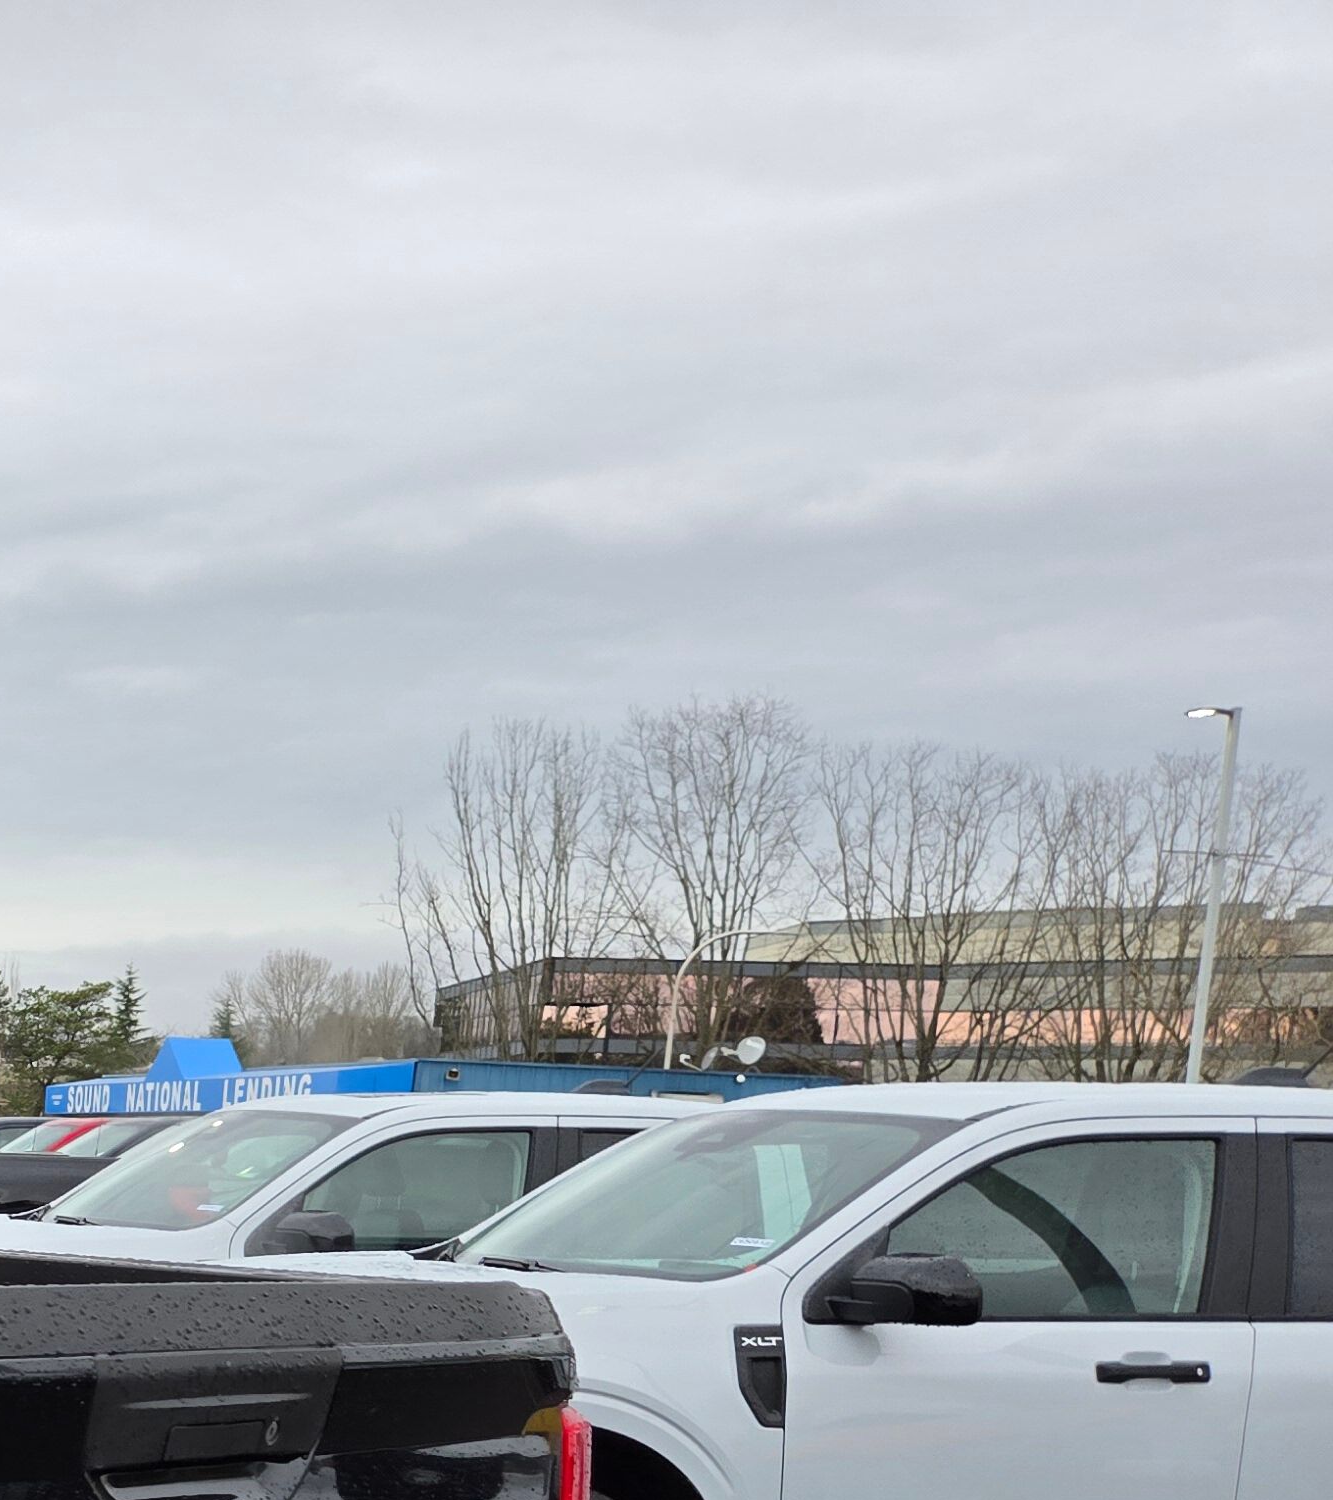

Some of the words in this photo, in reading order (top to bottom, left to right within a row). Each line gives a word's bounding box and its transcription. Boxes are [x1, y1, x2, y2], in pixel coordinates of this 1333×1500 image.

[66, 1084, 111, 1113] SOUND
[125, 1079, 202, 1113] NATIONAL
[221, 1073, 313, 1107] LENDING
[740, 1336, 783, 1347] XLT
